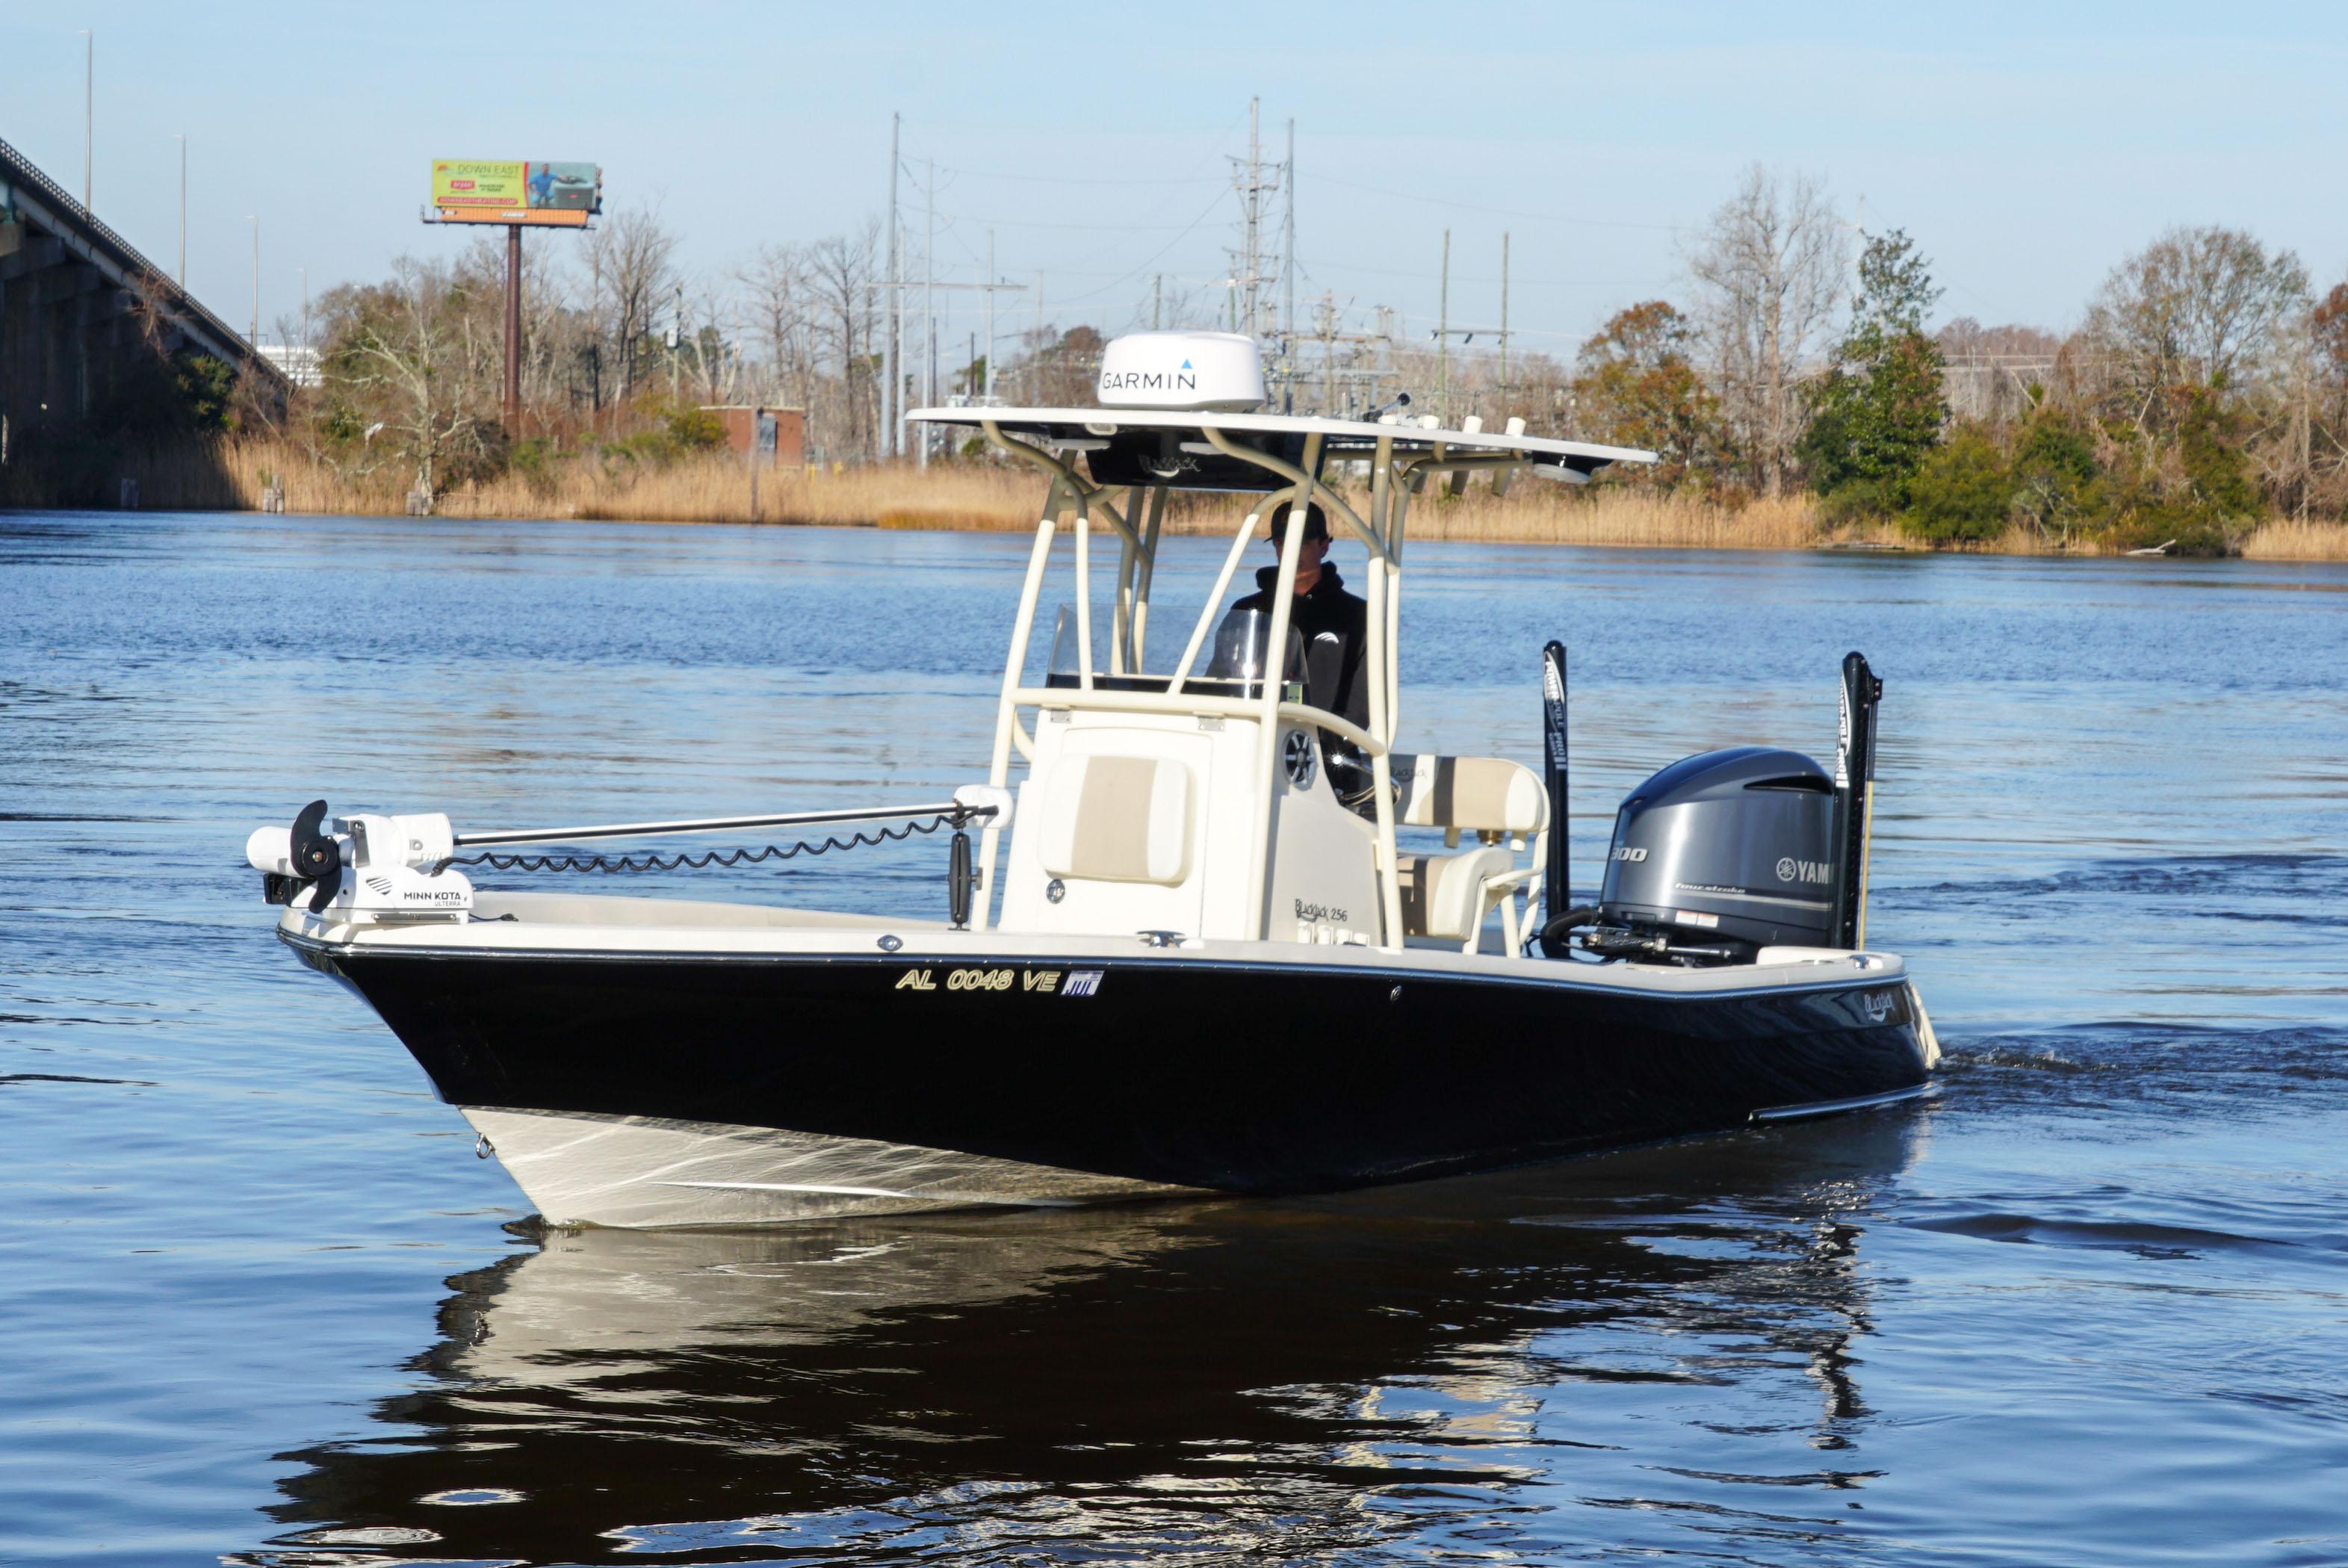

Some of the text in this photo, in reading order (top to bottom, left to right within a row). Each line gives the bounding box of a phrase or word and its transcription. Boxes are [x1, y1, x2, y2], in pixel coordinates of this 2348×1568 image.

[458, 164, 519, 174] DOWN EAST
[1103, 373, 1195, 389] GARMIN
[1797, 860, 1834, 884] YAM
[404, 892, 461, 900] MINN KOTA
[1331, 908, 1348, 922] 256
[895, 969, 1061, 992] AL 0048 VE
[1064, 980, 1092, 996] JUL
